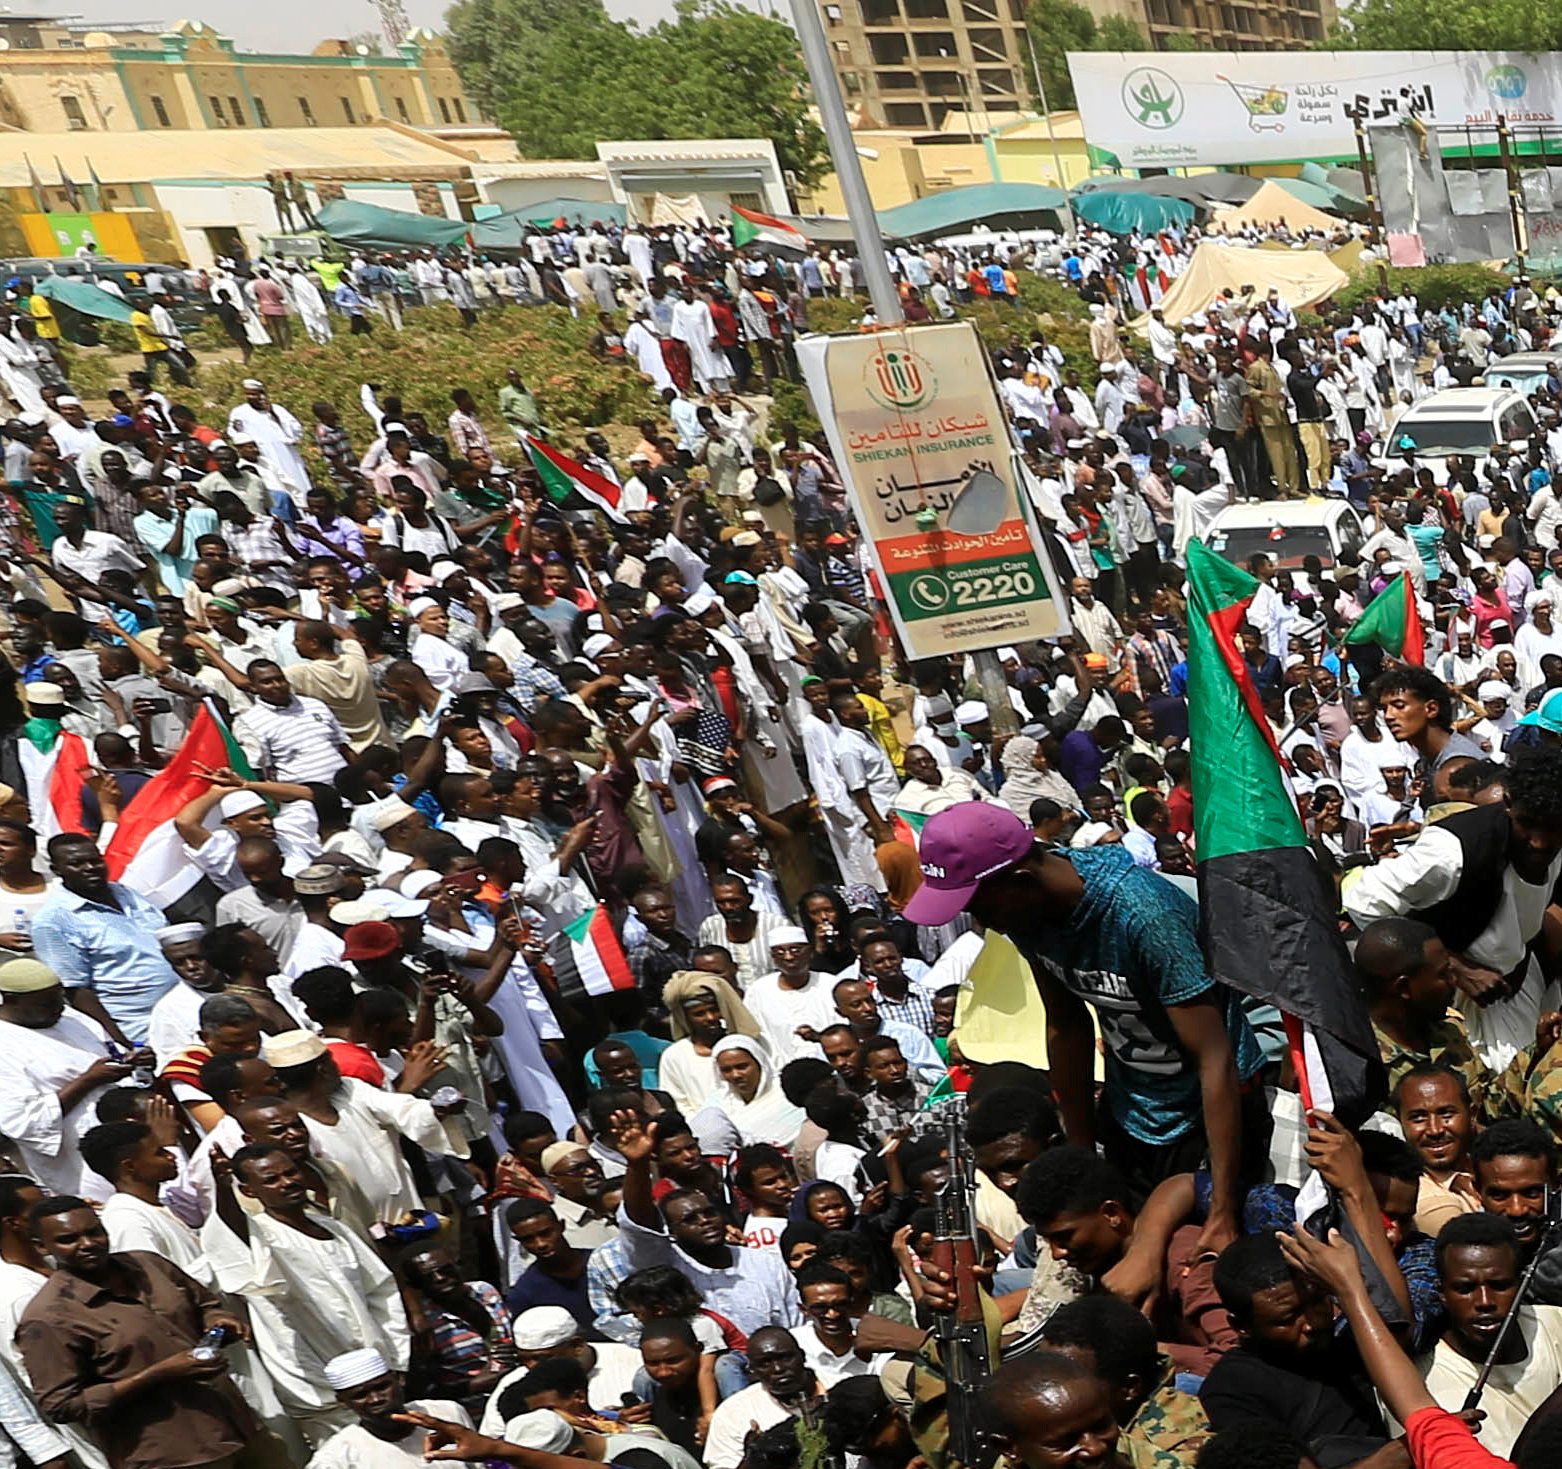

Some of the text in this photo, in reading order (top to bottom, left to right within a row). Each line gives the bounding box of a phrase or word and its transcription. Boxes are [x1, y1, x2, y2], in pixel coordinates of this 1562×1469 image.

[927, 412, 988, 438] شيكان
[853, 434, 995, 463] SHIEKAN INSURANCE
[947, 560, 1029, 580] Customer Care
[953, 571, 1036, 605] 2220
